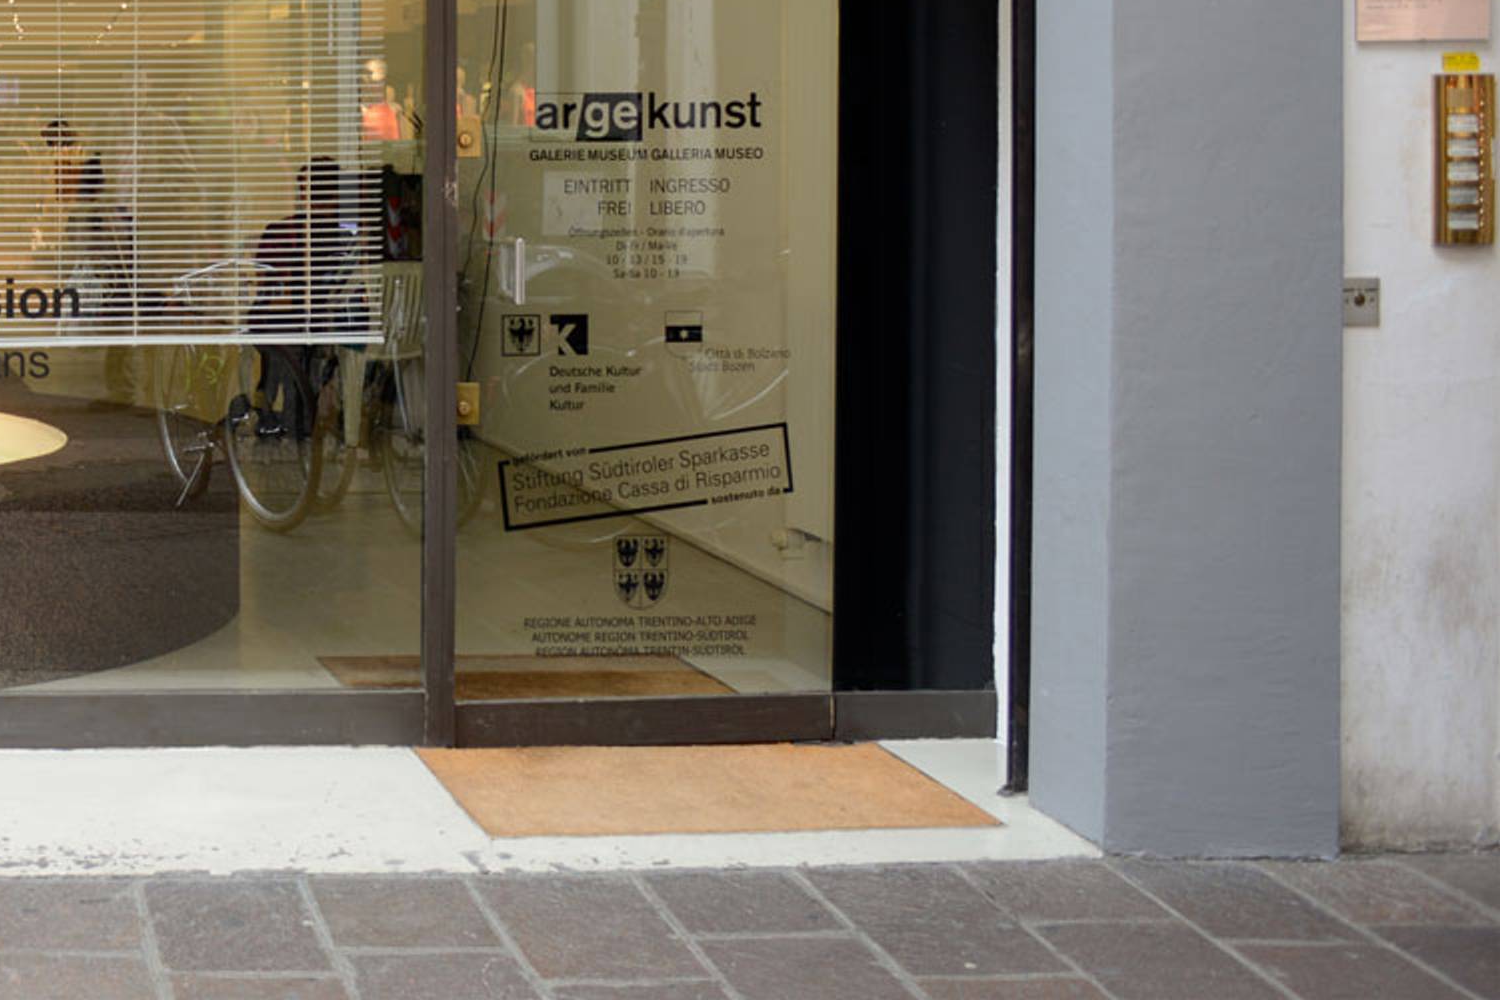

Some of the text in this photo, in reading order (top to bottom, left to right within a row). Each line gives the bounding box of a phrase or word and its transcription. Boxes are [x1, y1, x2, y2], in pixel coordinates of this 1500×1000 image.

[530, 146, 764, 162] GALERIE MUSEUM GALLERIA MUSEO
[564, 178, 633, 195] EINTRITT
[649, 177, 731, 194] INGRESSO
[598, 200, 632, 216] FREI
[649, 200, 707, 216] LIBERO
[549, 365, 642, 377] Deutsche Kultur
[549, 382, 616, 393] und Familie
[549, 399, 585, 411] Kultur
[512, 442, 770, 491] Stiftung Südtiroler Sparkasse
[514, 463, 782, 514] Fondazione Cassa di Risparmio
[524, 614, 757, 628] REGIONE AUTONOMA TRENTINO-ALTO ADIGE
[532, 631, 591, 643] AUTONOME
[594, 631, 636, 643] REGION
